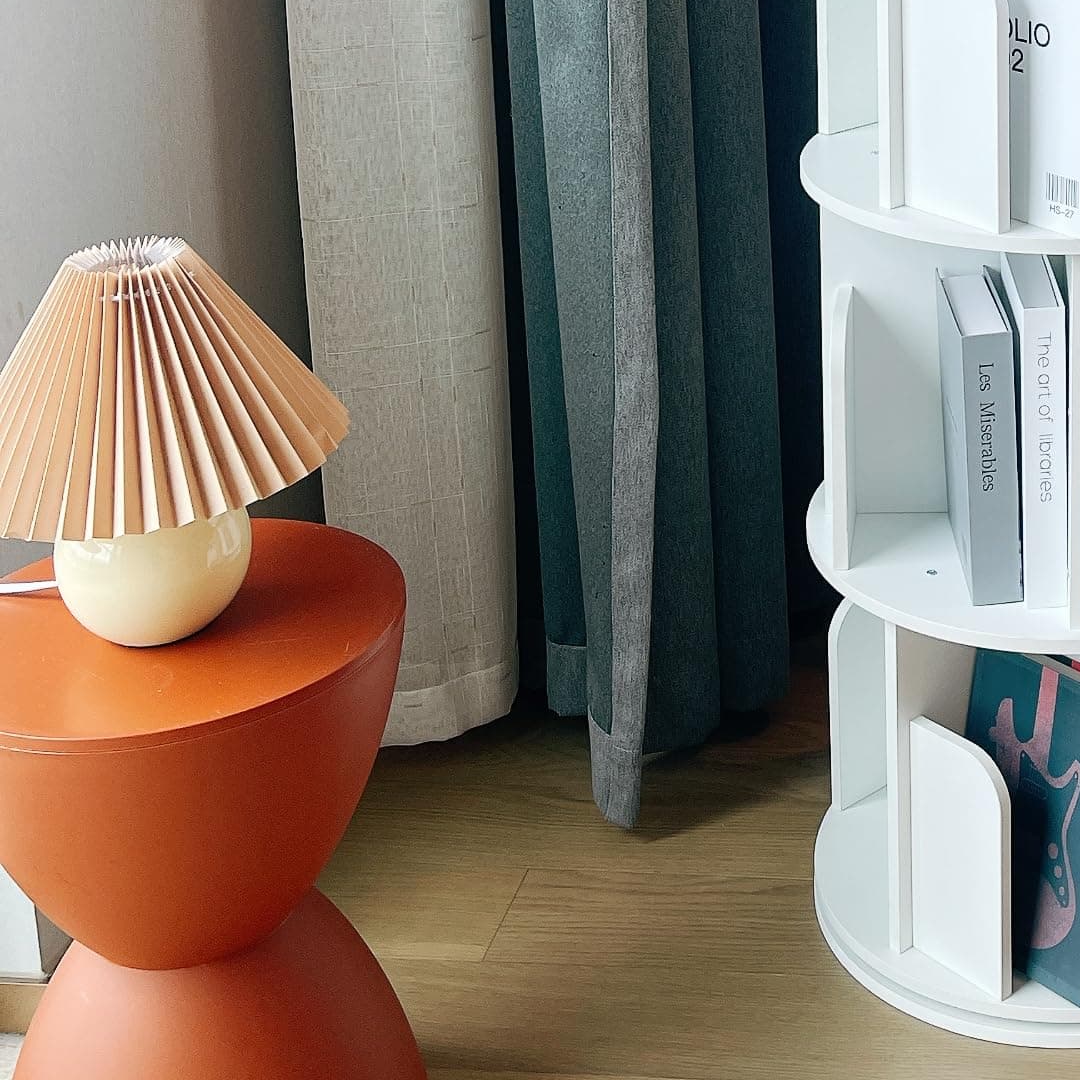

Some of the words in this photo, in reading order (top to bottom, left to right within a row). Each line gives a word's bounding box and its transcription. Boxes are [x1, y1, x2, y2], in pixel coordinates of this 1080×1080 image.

[1049, 204, 1075, 220] HS-27
[1036, 331, 1052, 369] The
[978, 362, 995, 392] Les
[1037, 373, 1053, 400] art
[1038, 405, 1054, 427] of
[979, 402, 995, 493] Miserables
[1038, 433, 1055, 504] libraries
